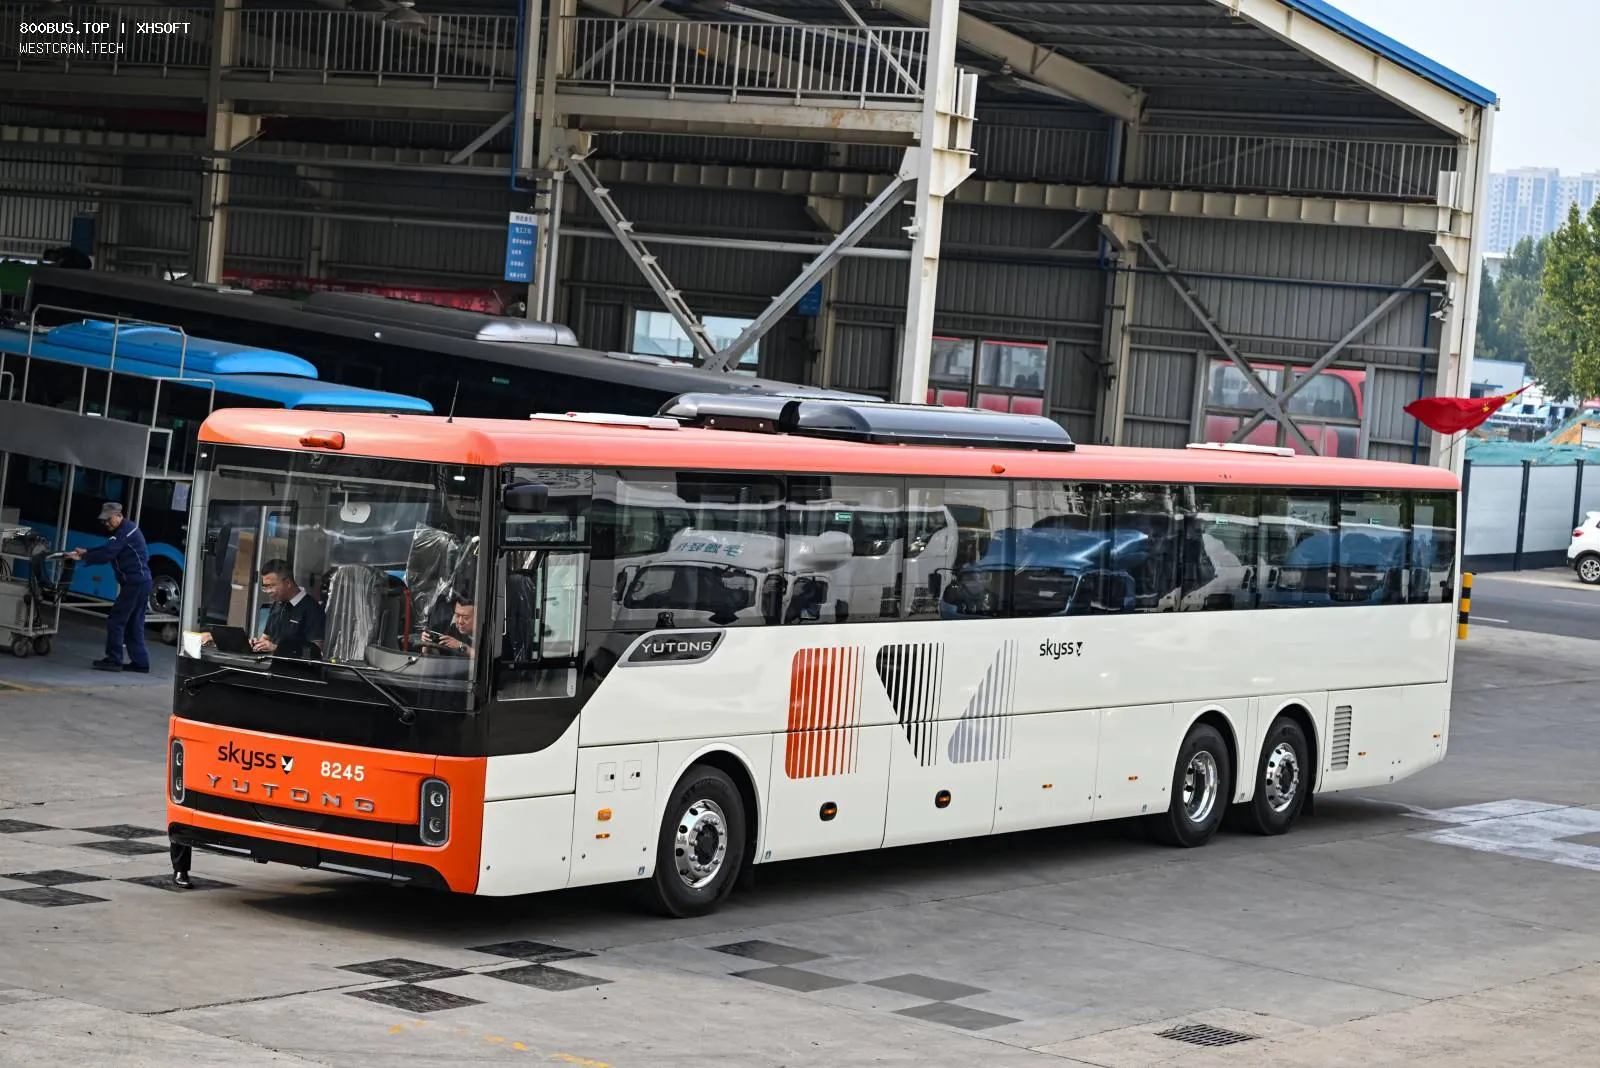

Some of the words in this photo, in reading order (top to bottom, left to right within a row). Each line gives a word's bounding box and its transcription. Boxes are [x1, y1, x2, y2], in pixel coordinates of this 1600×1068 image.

[641, 641, 713, 654] YUTONG
[1039, 638, 1074, 660] skyss
[218, 741, 277, 771] skyss
[320, 761, 365, 782] 8245
[207, 774, 375, 812] YUTONG
